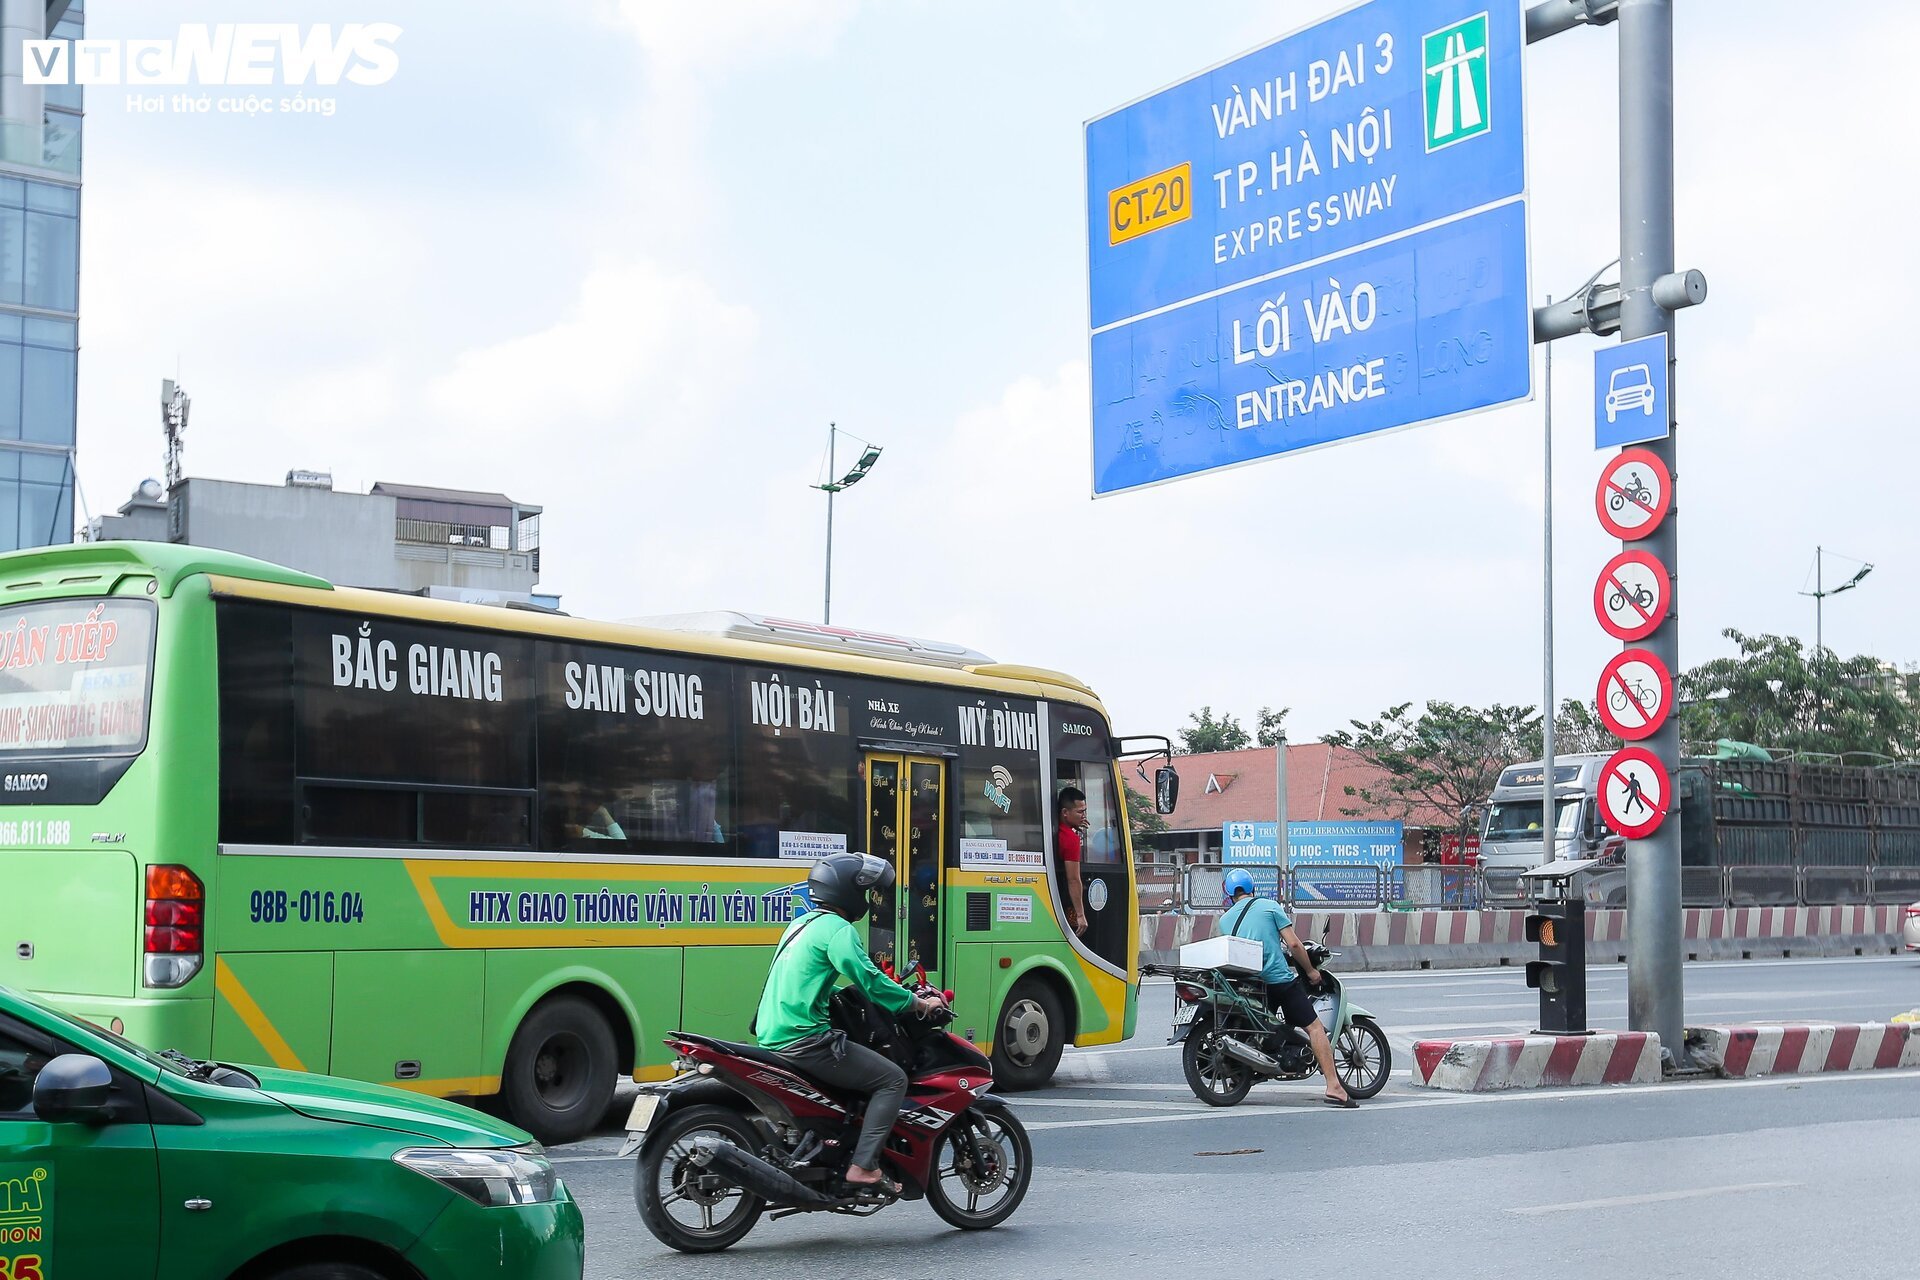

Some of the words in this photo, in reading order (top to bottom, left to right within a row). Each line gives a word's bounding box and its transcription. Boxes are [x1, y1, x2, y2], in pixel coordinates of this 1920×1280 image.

[1211, 71, 1297, 140] VÀNH
[1307, 43, 1365, 103] ĐAI
[1374, 32, 1394, 75] 3
[1331, 105, 1393, 169] NỘI
[1114, 175, 1185, 232] CT.20
[1214, 174, 1398, 265] EXPRESSWAY
[1233, 291, 1290, 365] LỐI
[1303, 276, 1377, 344] VÀO
[1236, 358, 1385, 430] ENTRANCE
[55, 602, 118, 664] TIẾP
[332, 621, 398, 692] BẮC
[408, 643, 503, 702] GIANG
[565, 661, 626, 714] SAM
[634, 669, 704, 720] SUNG
[751, 673, 792, 736] NỘI
[798, 679, 836, 733] BÀI
[868, 698, 887, 712] NHÀ
[888, 703, 900, 713] XE
[958, 700, 987, 747] MỸ
[992, 702, 1038, 750] ĐÌNH
[1062, 723, 1093, 736] SAMCO
[4, 774, 48, 791] SAMCO
[91, 832, 127, 843] FELIX
[1230, 843, 1271, 857] TRƯỜNG
[1300, 845, 1321, 859] HỌC
[1332, 845, 1359, 857] THCS
[1370, 844, 1396, 857] THPT
[1316, 827, 1355, 835] HERMANN
[1357, 827, 1395, 835] GMEINER
[250, 889, 364, 923] 98B-016.04
[470, 891, 512, 923] HTX
[518, 892, 567, 923] GIAO
[573, 887, 639, 923] THÔNG
[644, 888, 683, 929] VẬN
[688, 883, 716, 923] TẢI
[722, 889, 756, 923] YÊN
[761, 885, 793, 923] THẾ
